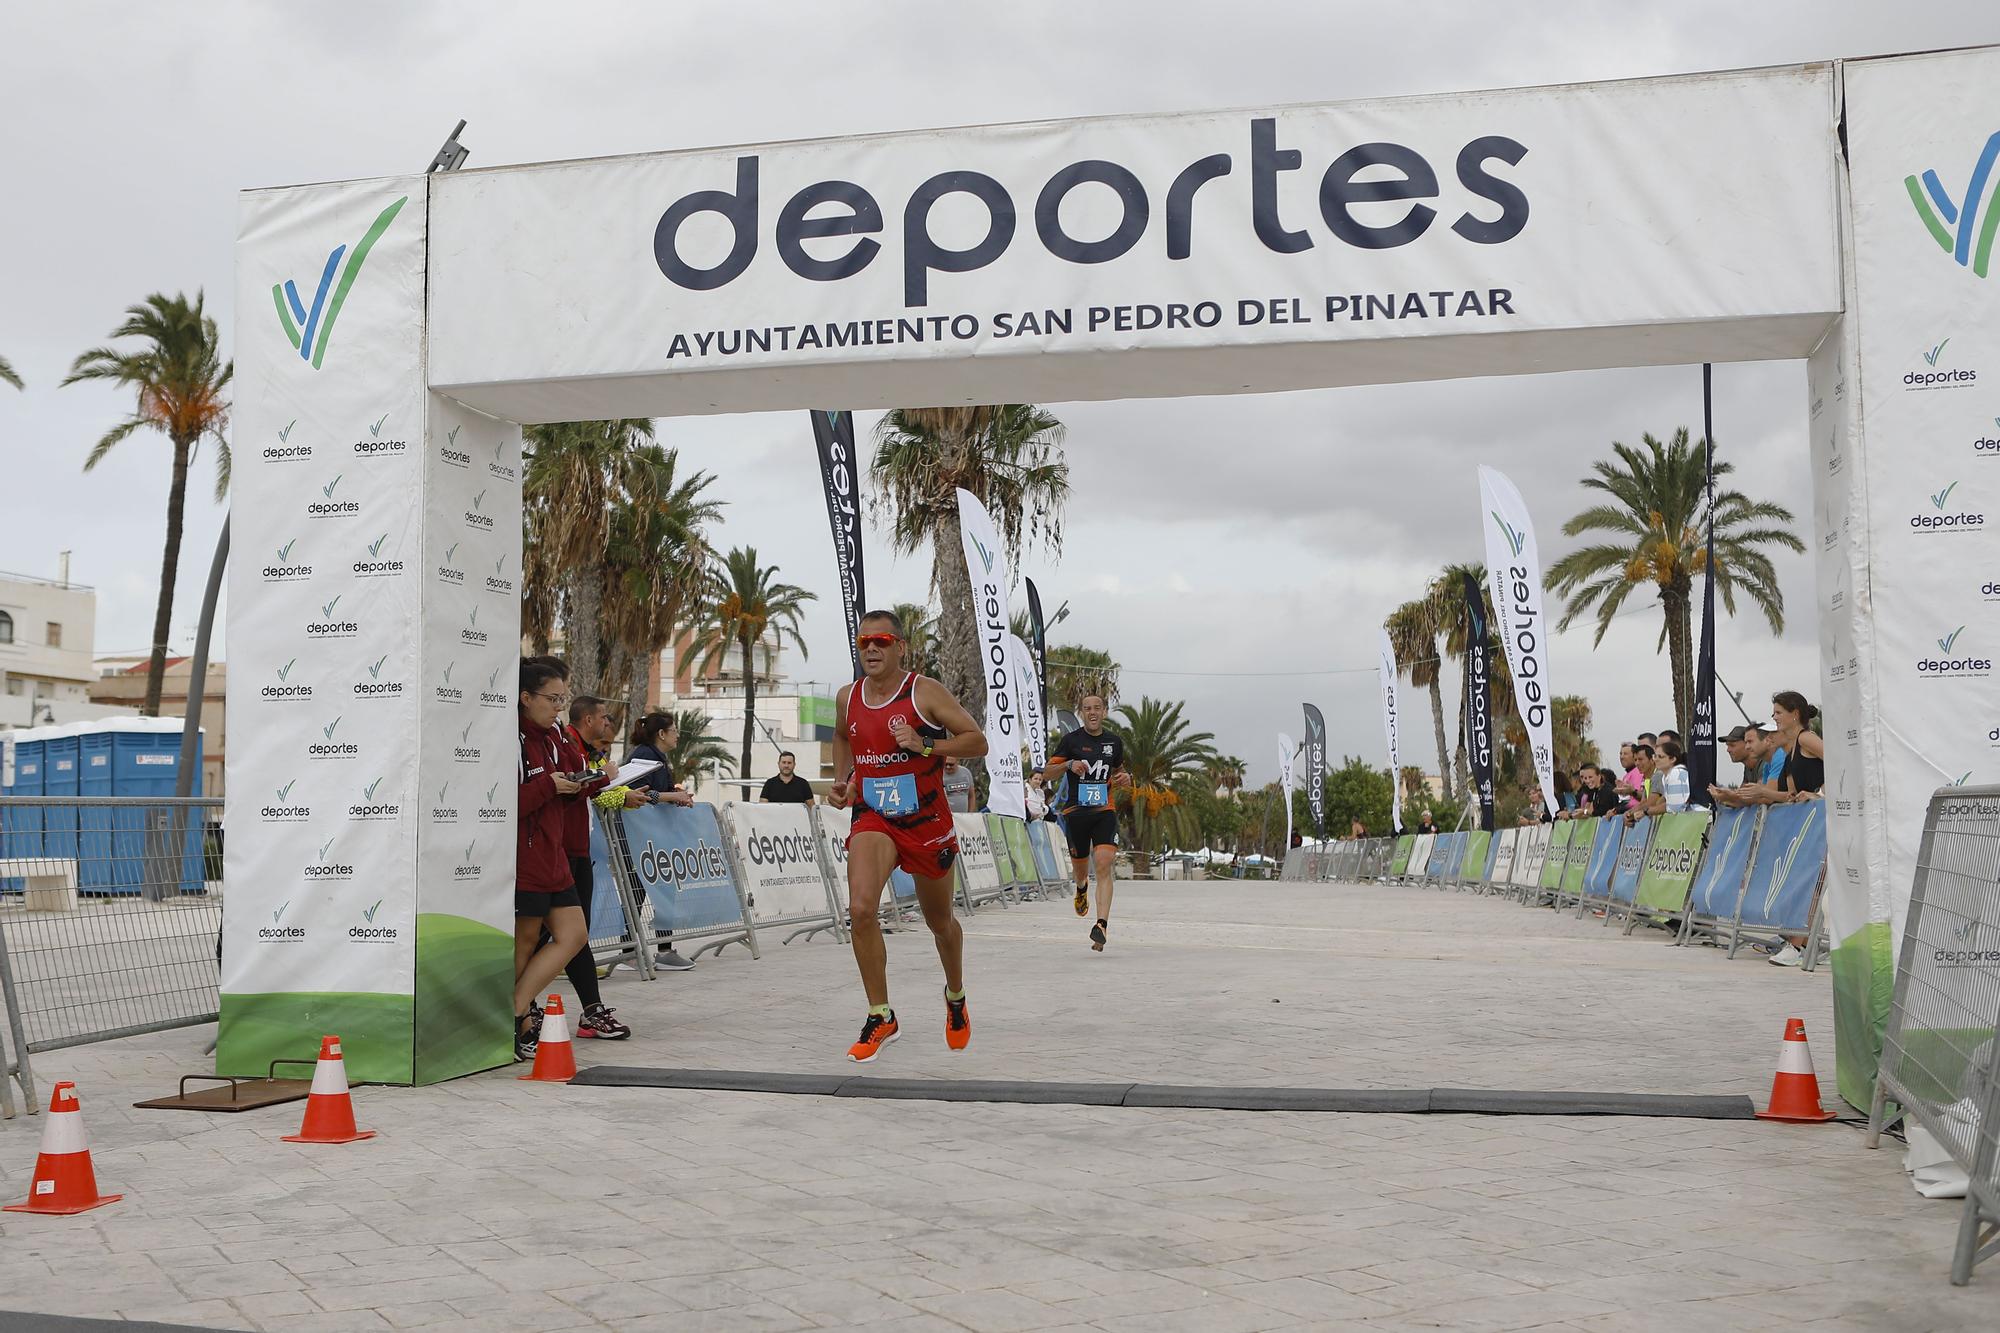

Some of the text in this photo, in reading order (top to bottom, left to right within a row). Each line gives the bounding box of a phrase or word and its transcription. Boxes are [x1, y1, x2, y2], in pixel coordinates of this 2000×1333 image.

[653, 118, 1530, 307] deportes
[666, 288, 1516, 360] AYUNTAMIENTO SAN PEDRO DEL PINATAR
[1904, 369, 1976, 386] deportes
[263, 445, 312, 459] deportes
[354, 439, 405, 454] deportes
[308, 501, 359, 515] deportes
[1911, 513, 1984, 529] deportes
[263, 565, 312, 579] deportes
[353, 560, 403, 575] deportes
[307, 621, 358, 636] deportes
[1917, 657, 1991, 673] deportes
[262, 684, 312, 699] deportes
[354, 681, 402, 695] deportes
[309, 742, 358, 757] deportes
[856, 752, 909, 764] MARINOCIO
[876, 788, 901, 807] 74
[1087, 790, 1101, 801] 78
[262, 805, 310, 820] deportes
[349, 804, 399, 818] deportes
[304, 863, 353, 878] deportes
[640, 838, 727, 892] deportes
[259, 926, 305, 940] deportes
[349, 926, 397, 940] deportes
